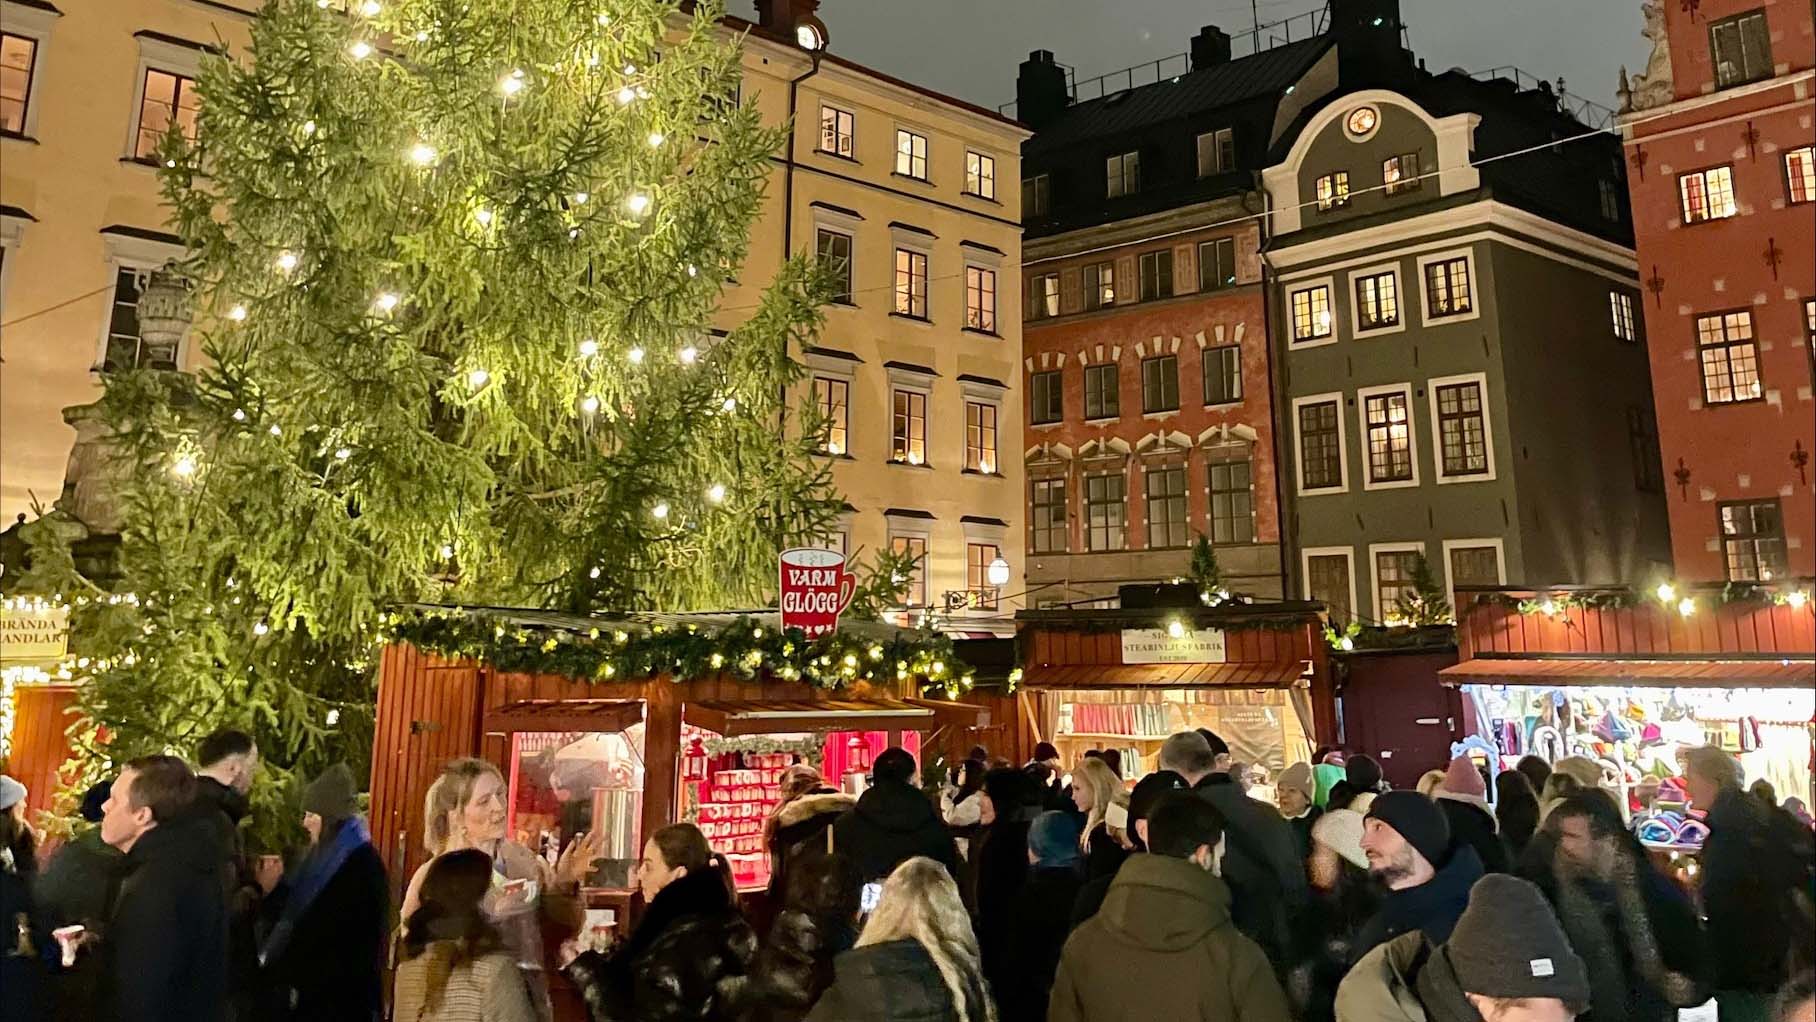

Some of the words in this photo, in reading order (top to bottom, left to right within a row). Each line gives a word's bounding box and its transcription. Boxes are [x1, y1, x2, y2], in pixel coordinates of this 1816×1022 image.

[788, 569, 837, 587] VARM
[783, 588, 838, 613] GLÖGG
[1, 633, 60, 644] ANDLAR
